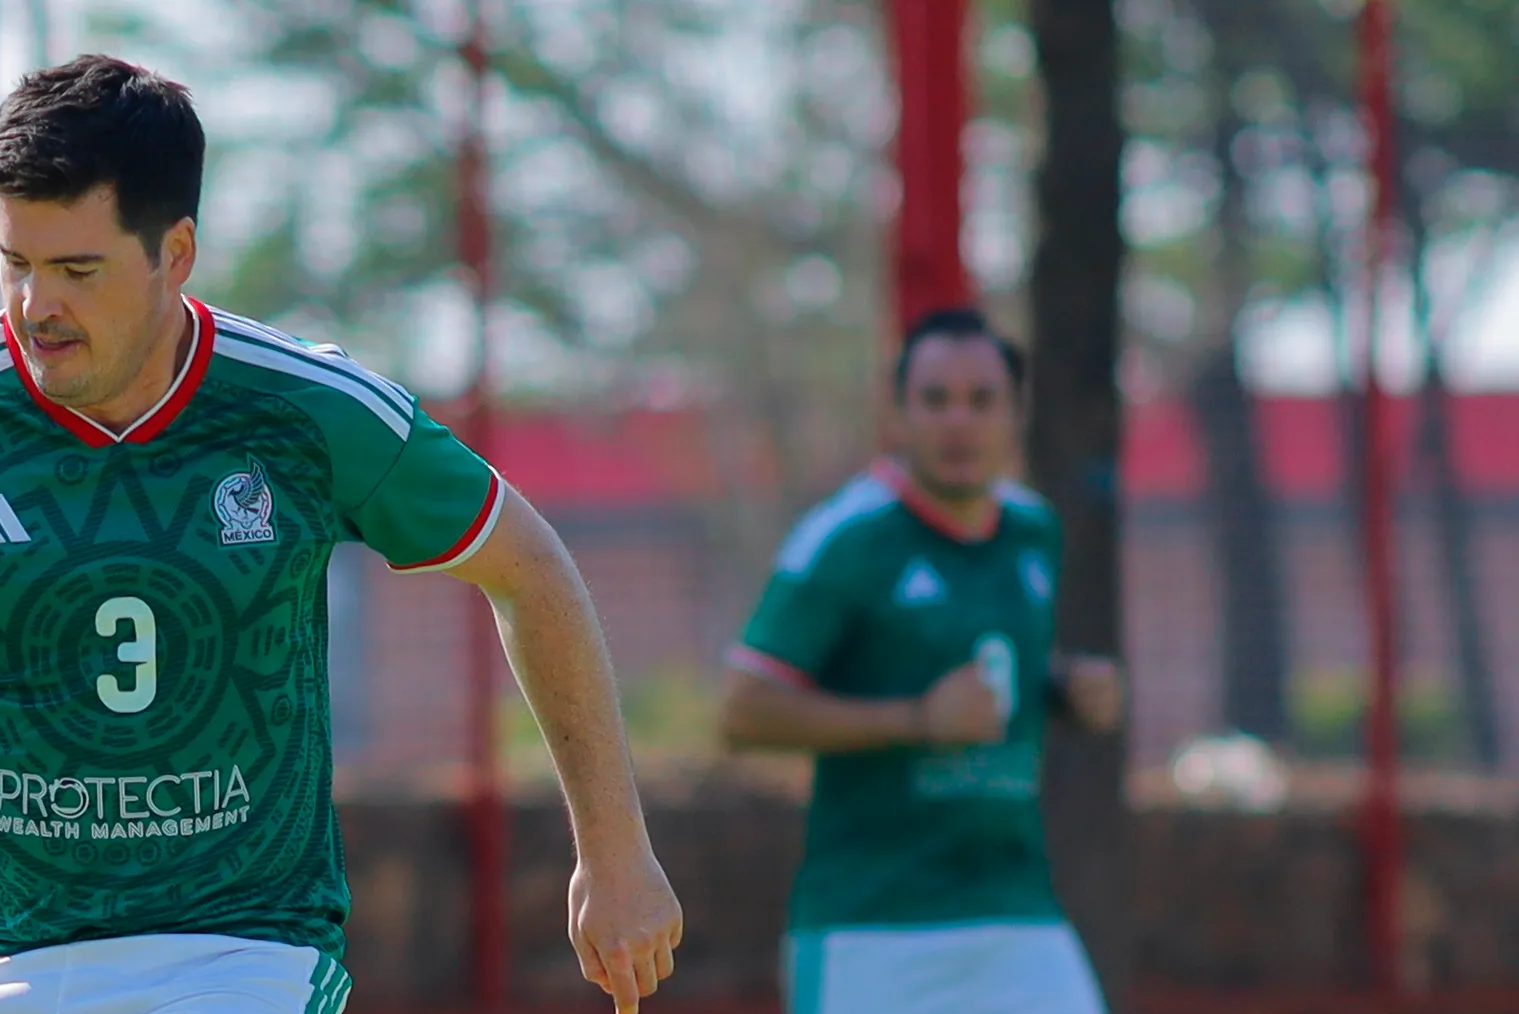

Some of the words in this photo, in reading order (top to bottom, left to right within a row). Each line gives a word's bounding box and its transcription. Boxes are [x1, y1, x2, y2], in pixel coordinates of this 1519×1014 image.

[223, 528, 272, 542] MÉXICO
[95, 596, 157, 713] 3
[91, 805, 250, 839] MANAGEMENT
